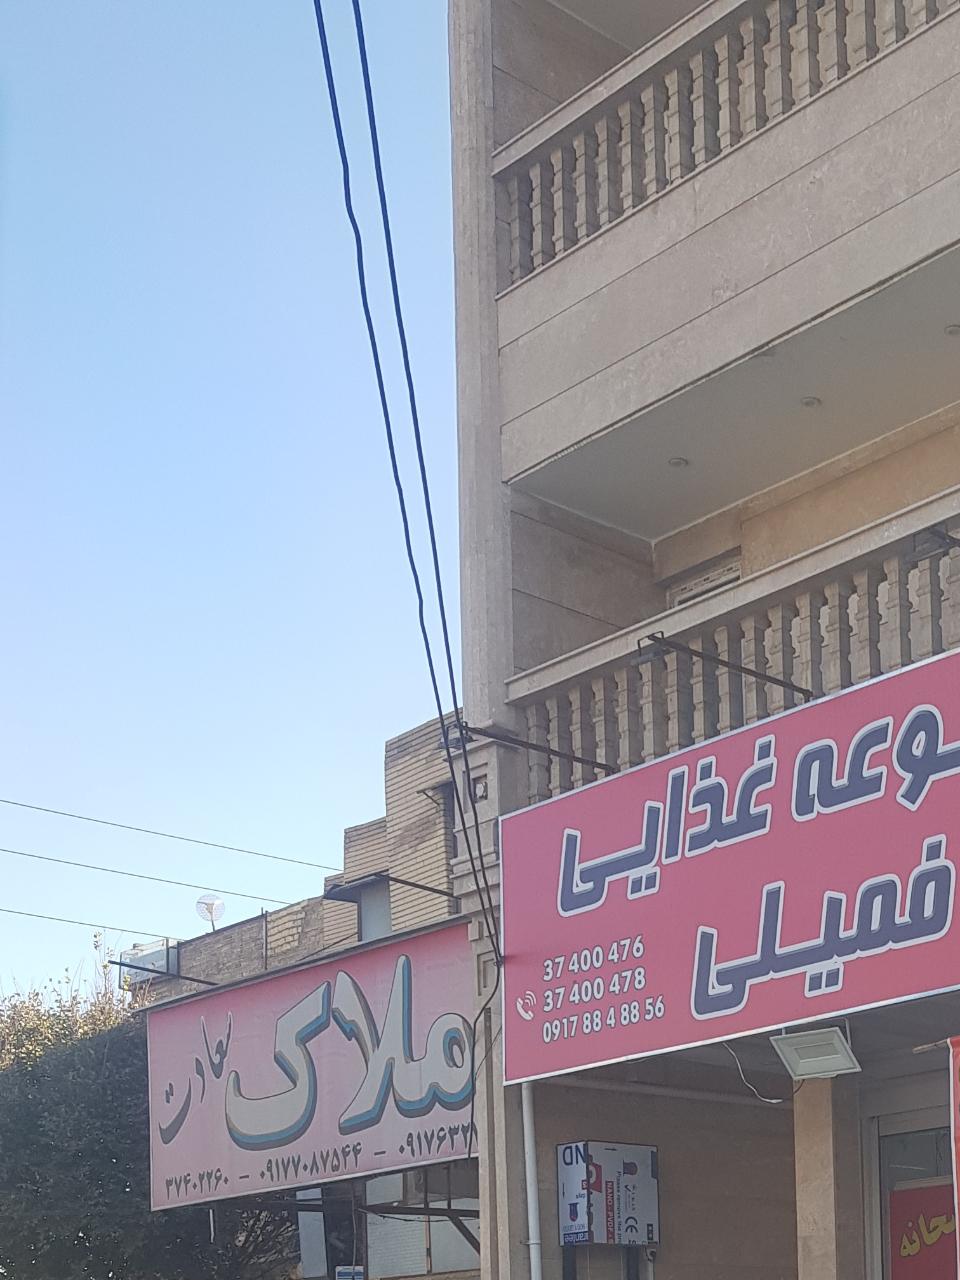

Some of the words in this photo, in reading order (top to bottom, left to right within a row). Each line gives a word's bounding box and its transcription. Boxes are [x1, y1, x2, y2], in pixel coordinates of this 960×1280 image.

[557, 734, 777, 917] غذایی
[691, 834, 957, 1020] فمیلی
[543, 955, 566, 981] 37
[568, 946, 604, 973] 400
[607, 935, 644, 963] 476
[543, 986, 566, 1012] 37
[569, 977, 605, 1004] 400
[608, 967, 646, 995] 478
[542, 1015, 578, 1043] 0917
[582, 1010, 602, 1034] 88
[619, 1000, 640, 1025] 88
[644, 995, 665, 1021] 56
